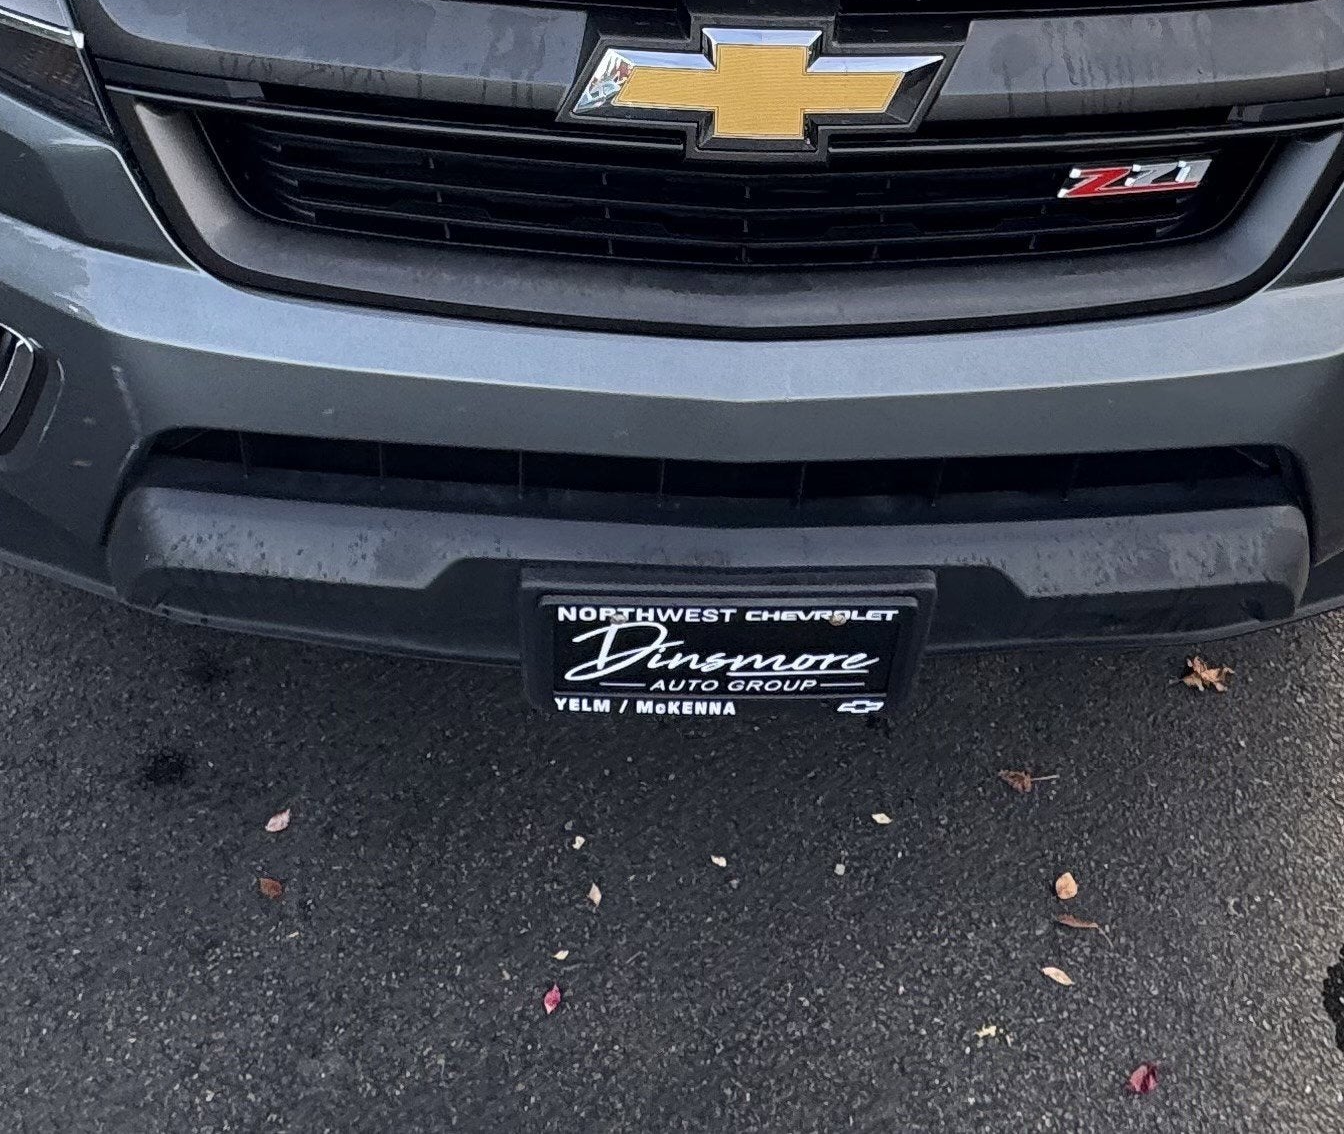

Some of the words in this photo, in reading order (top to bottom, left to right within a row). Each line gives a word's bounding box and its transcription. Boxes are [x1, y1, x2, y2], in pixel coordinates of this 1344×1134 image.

[1056, 159, 1213, 198] Z71
[557, 606, 737, 623] NORTHWEST
[744, 609, 900, 623] CHEVROLET
[564, 621, 880, 681] Dinsmore
[649, 679, 719, 692] AUTO
[727, 678, 818, 693] GROUP
[554, 697, 611, 713] YELM
[618, 699, 629, 714] /
[635, 700, 737, 715] McKENNA
